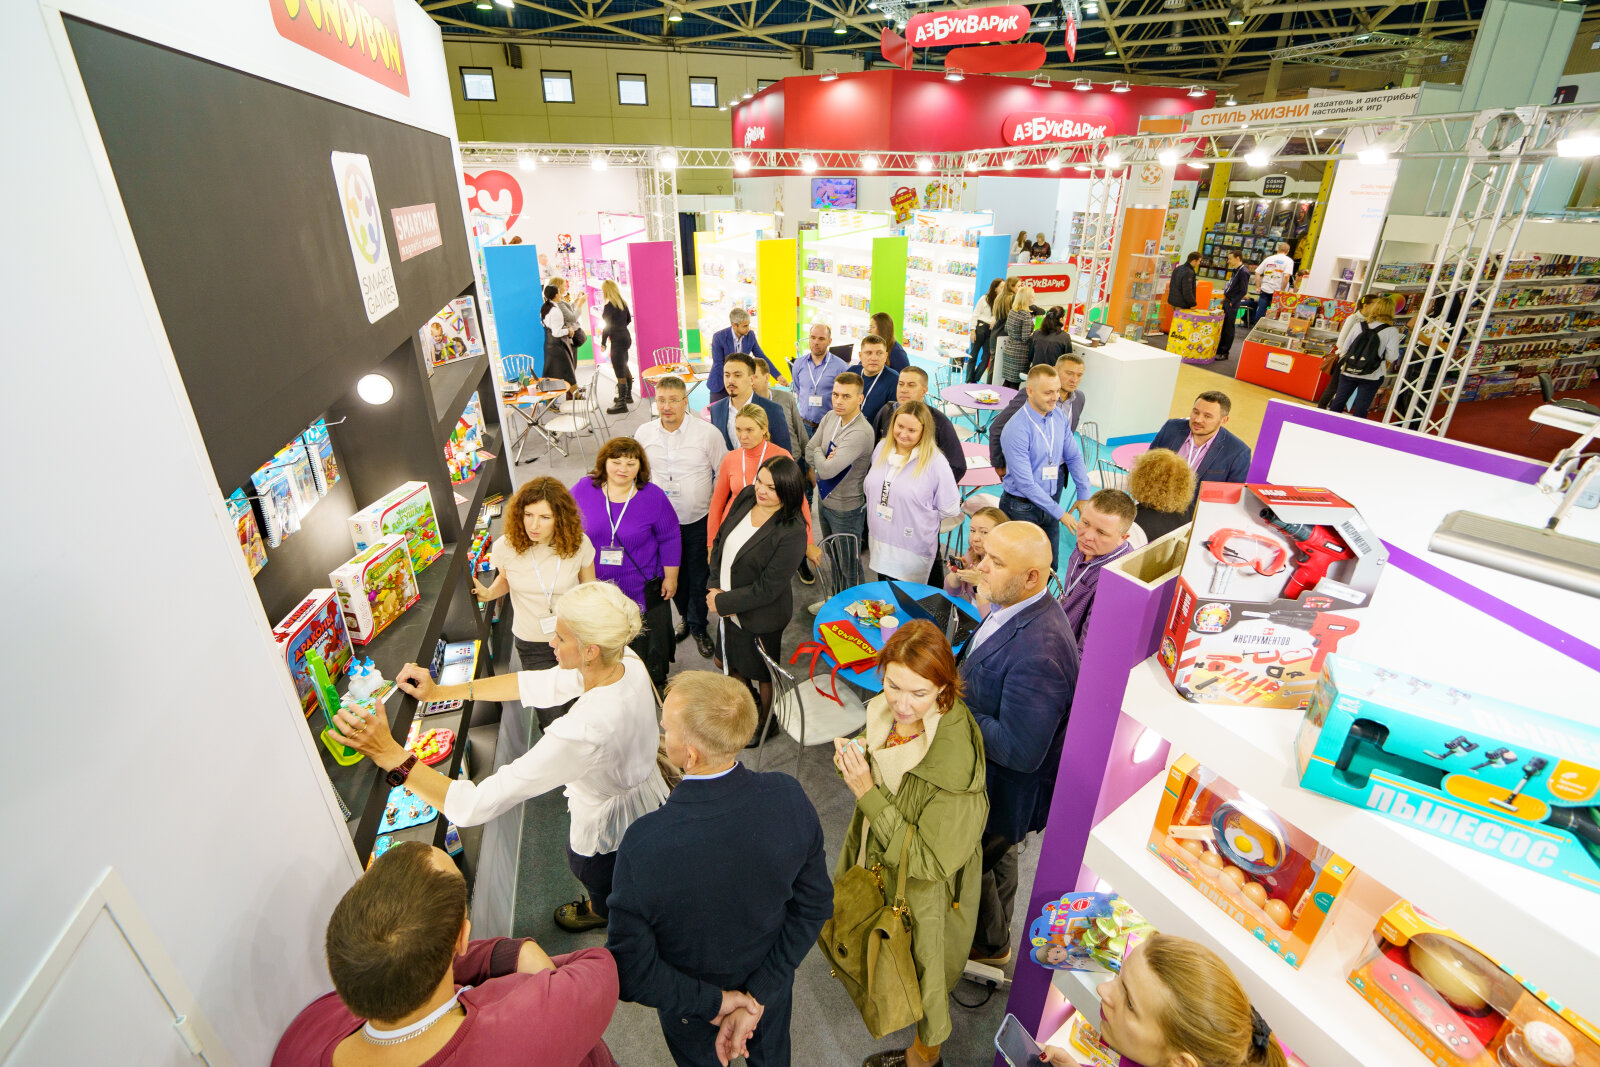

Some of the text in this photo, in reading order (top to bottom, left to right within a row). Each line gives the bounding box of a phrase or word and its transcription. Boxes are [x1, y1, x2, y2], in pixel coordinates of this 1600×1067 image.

[1200, 103, 1310, 126] СТИЛЬ ЖИЗНИ
[1312, 104, 1383, 116] настольных игр
[1313, 97, 1354, 108] издатель
[362, 266, 391, 295] SMART
[1020, 278, 1066, 288] ЗБУКВАРИК
[367, 285, 396, 316] GAMES
[295, 613, 335, 663] ДРАКОНЫ
[831, 624, 876, 655] BONDIBON
[1233, 634, 1291, 646] ИНСТРУМЕНТОВ
[1366, 784, 1560, 868] ПЫЛЕСОС
[1050, 898, 1071, 934] ДОКТОР
[1198, 881, 1245, 925] ПЛИТА
